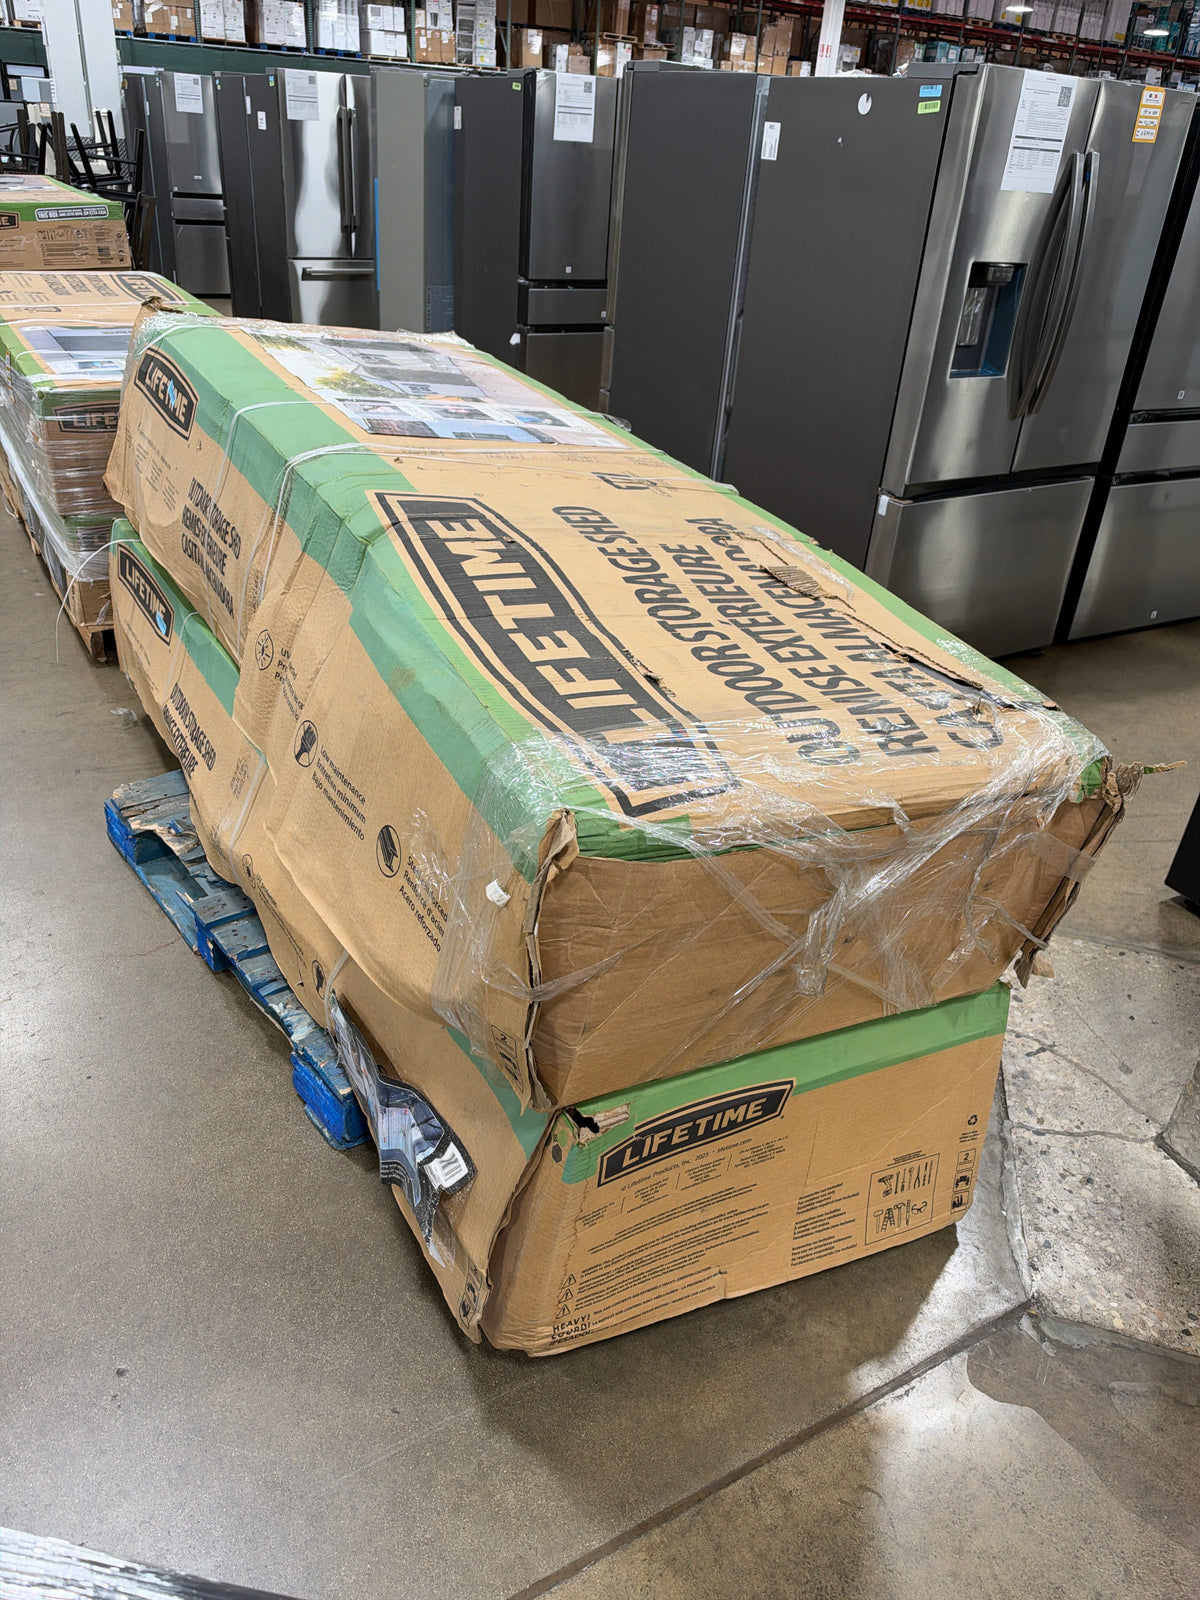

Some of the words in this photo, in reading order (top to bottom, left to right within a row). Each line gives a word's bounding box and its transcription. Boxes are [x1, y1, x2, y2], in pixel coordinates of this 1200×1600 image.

[552, 506, 639, 546] SHED
[598, 545, 704, 643] STORAGE
[659, 543, 828, 663] EXTÉRIEURE
[280, 647, 291, 659] UV
[428, 518, 653, 745] LIFETIME
[691, 644, 862, 767] OUTDOOR
[790, 664, 940, 757] REMISE
[311, 770, 323, 791] Bajo
[322, 786, 365, 841] mantenimiento
[316, 757, 337, 793] Entretien
[335, 787, 367, 825] minimum
[320, 744, 331, 763] Low
[329, 757, 366, 805] maintenance
[399, 885, 415, 914] Acero
[414, 907, 441, 953] reforzado
[402, 869, 427, 910] Renforcé
[426, 902, 445, 938] d'acier
[622, 1098, 767, 1168] LIFETIME
[963, 1153, 971, 1161] 2
[627, 1173, 653, 1190] Lifetime
[652, 1160, 681, 1178] Products,
[681, 1156, 693, 1168] Inc.
[694, 1151, 710, 1162] 2025
[552, 1314, 591, 1334] HEAVY!
